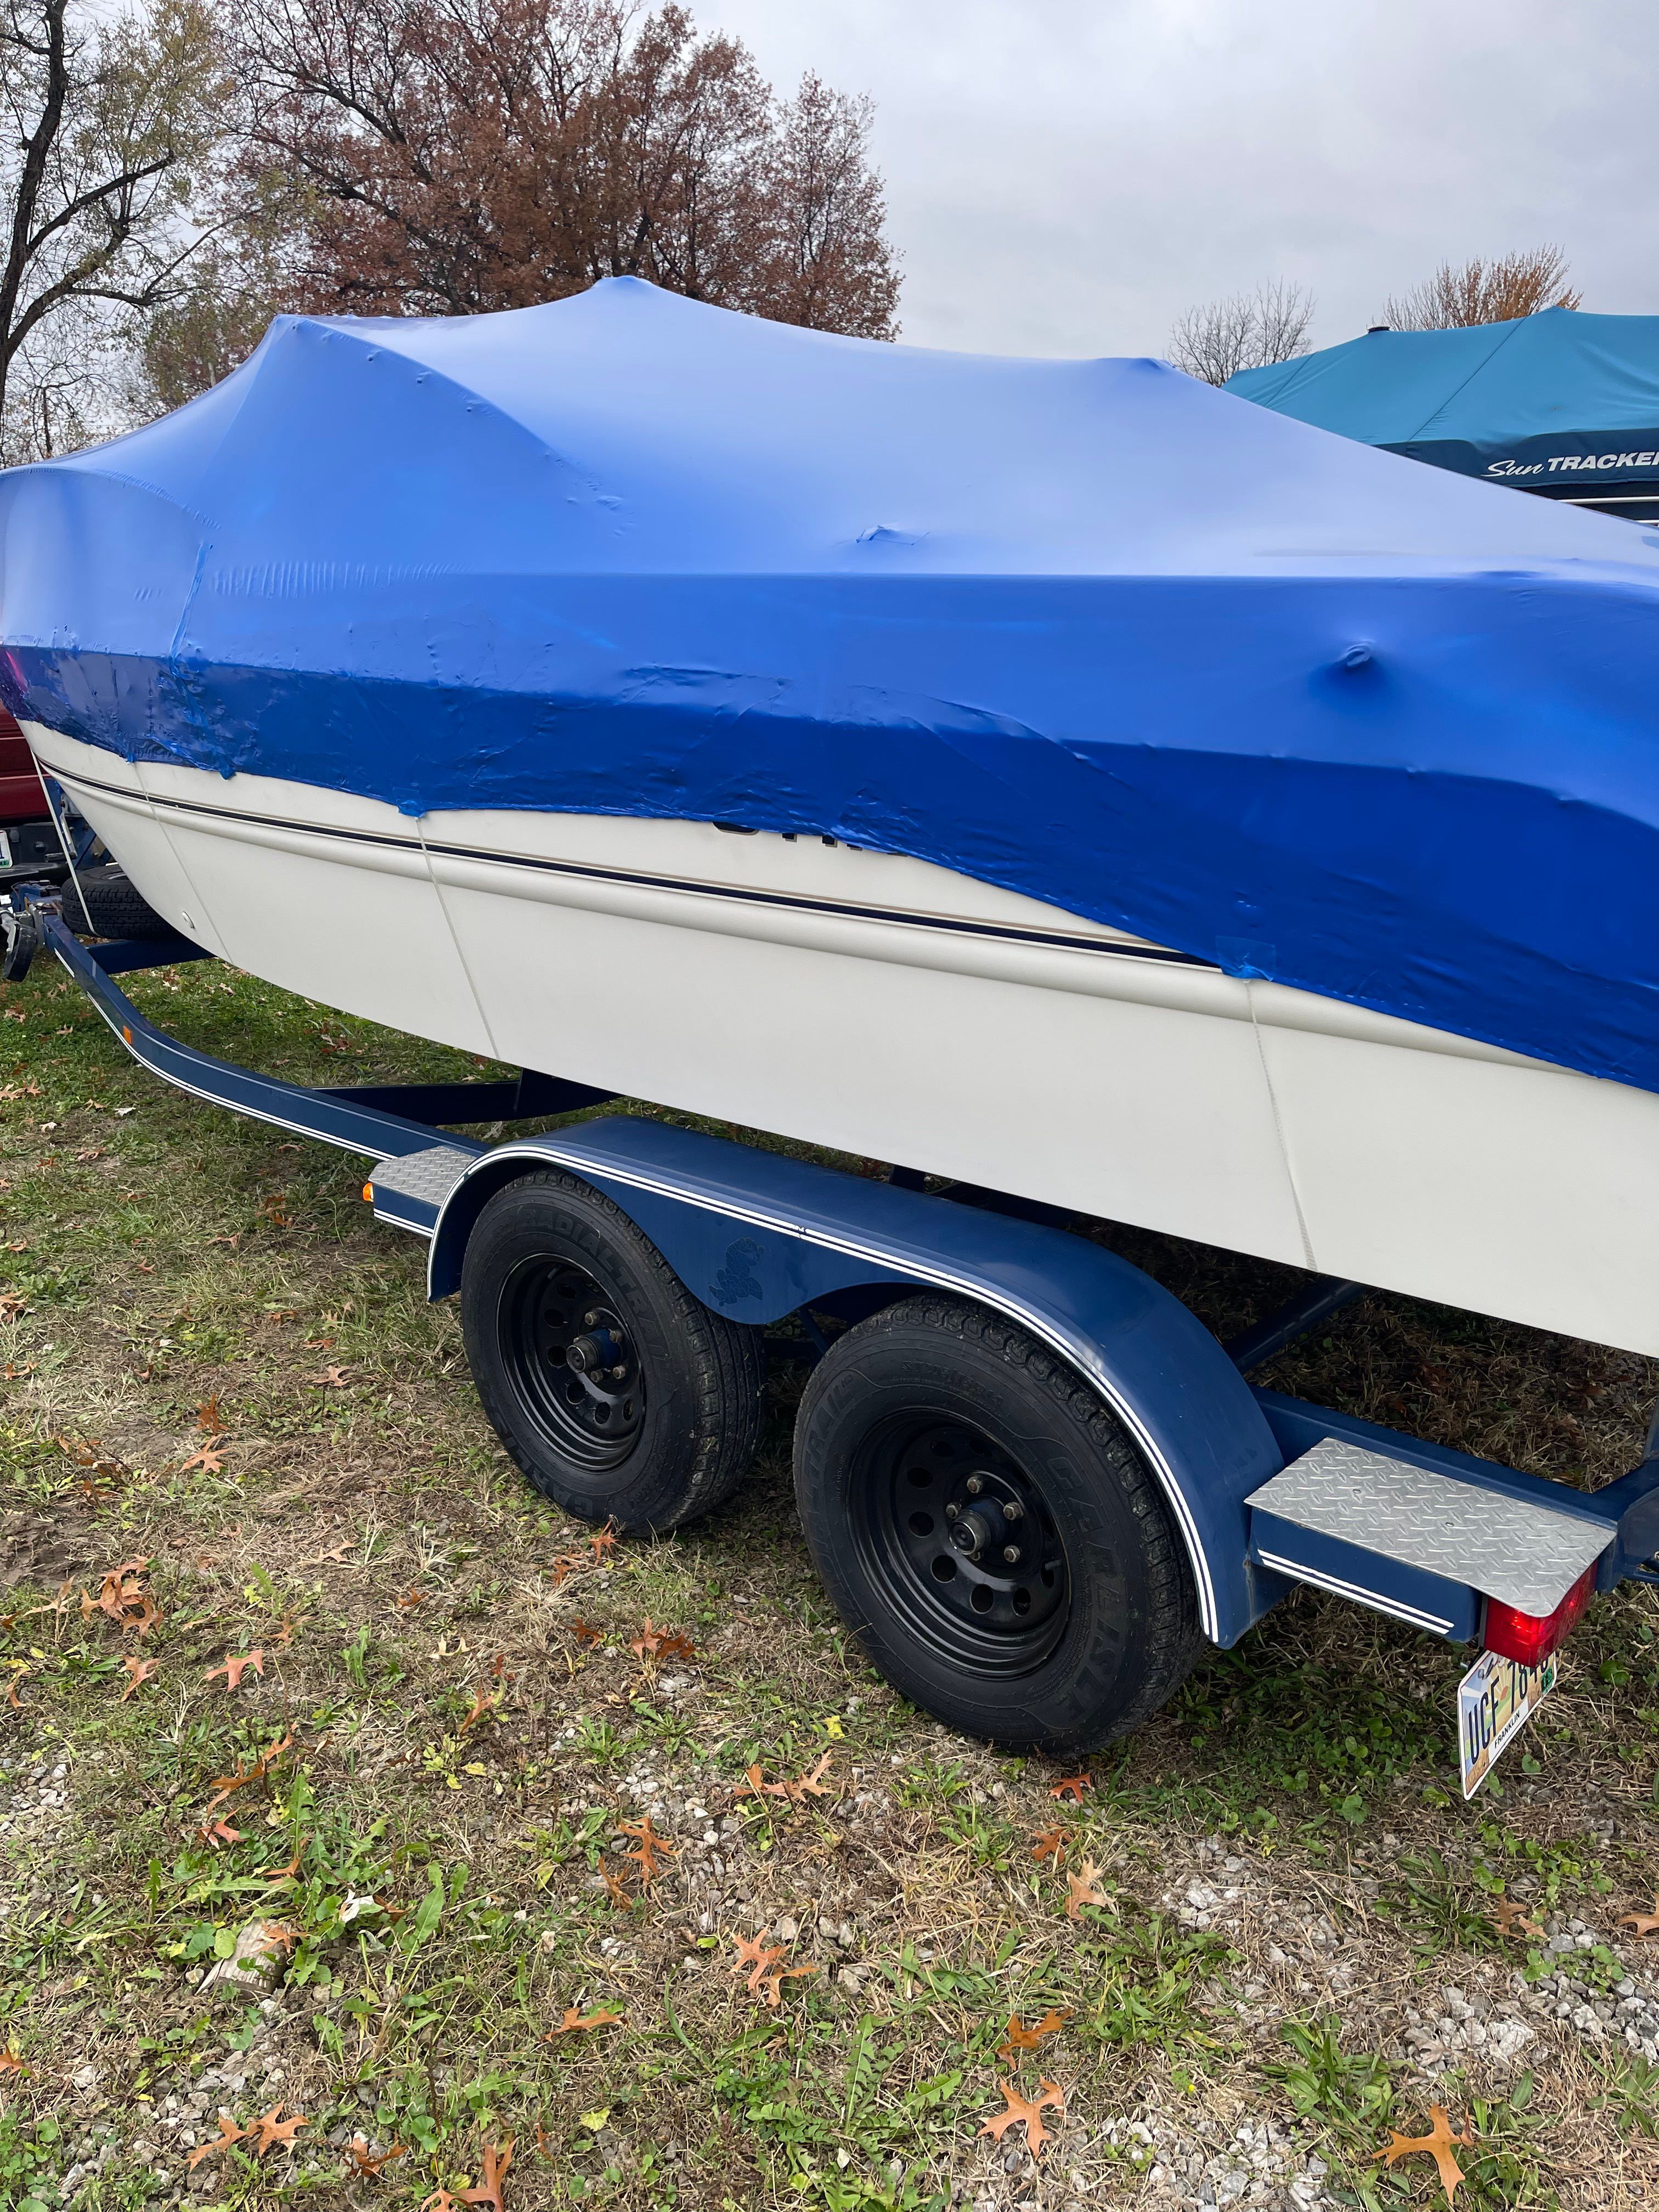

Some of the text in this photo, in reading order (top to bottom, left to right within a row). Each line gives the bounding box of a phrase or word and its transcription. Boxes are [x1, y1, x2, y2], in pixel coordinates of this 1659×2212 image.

[1481, 460, 1544, 477] Sun
[1469, 1675, 1499, 1765] UCF
[1494, 1711, 1520, 1748] FRANKLIN
